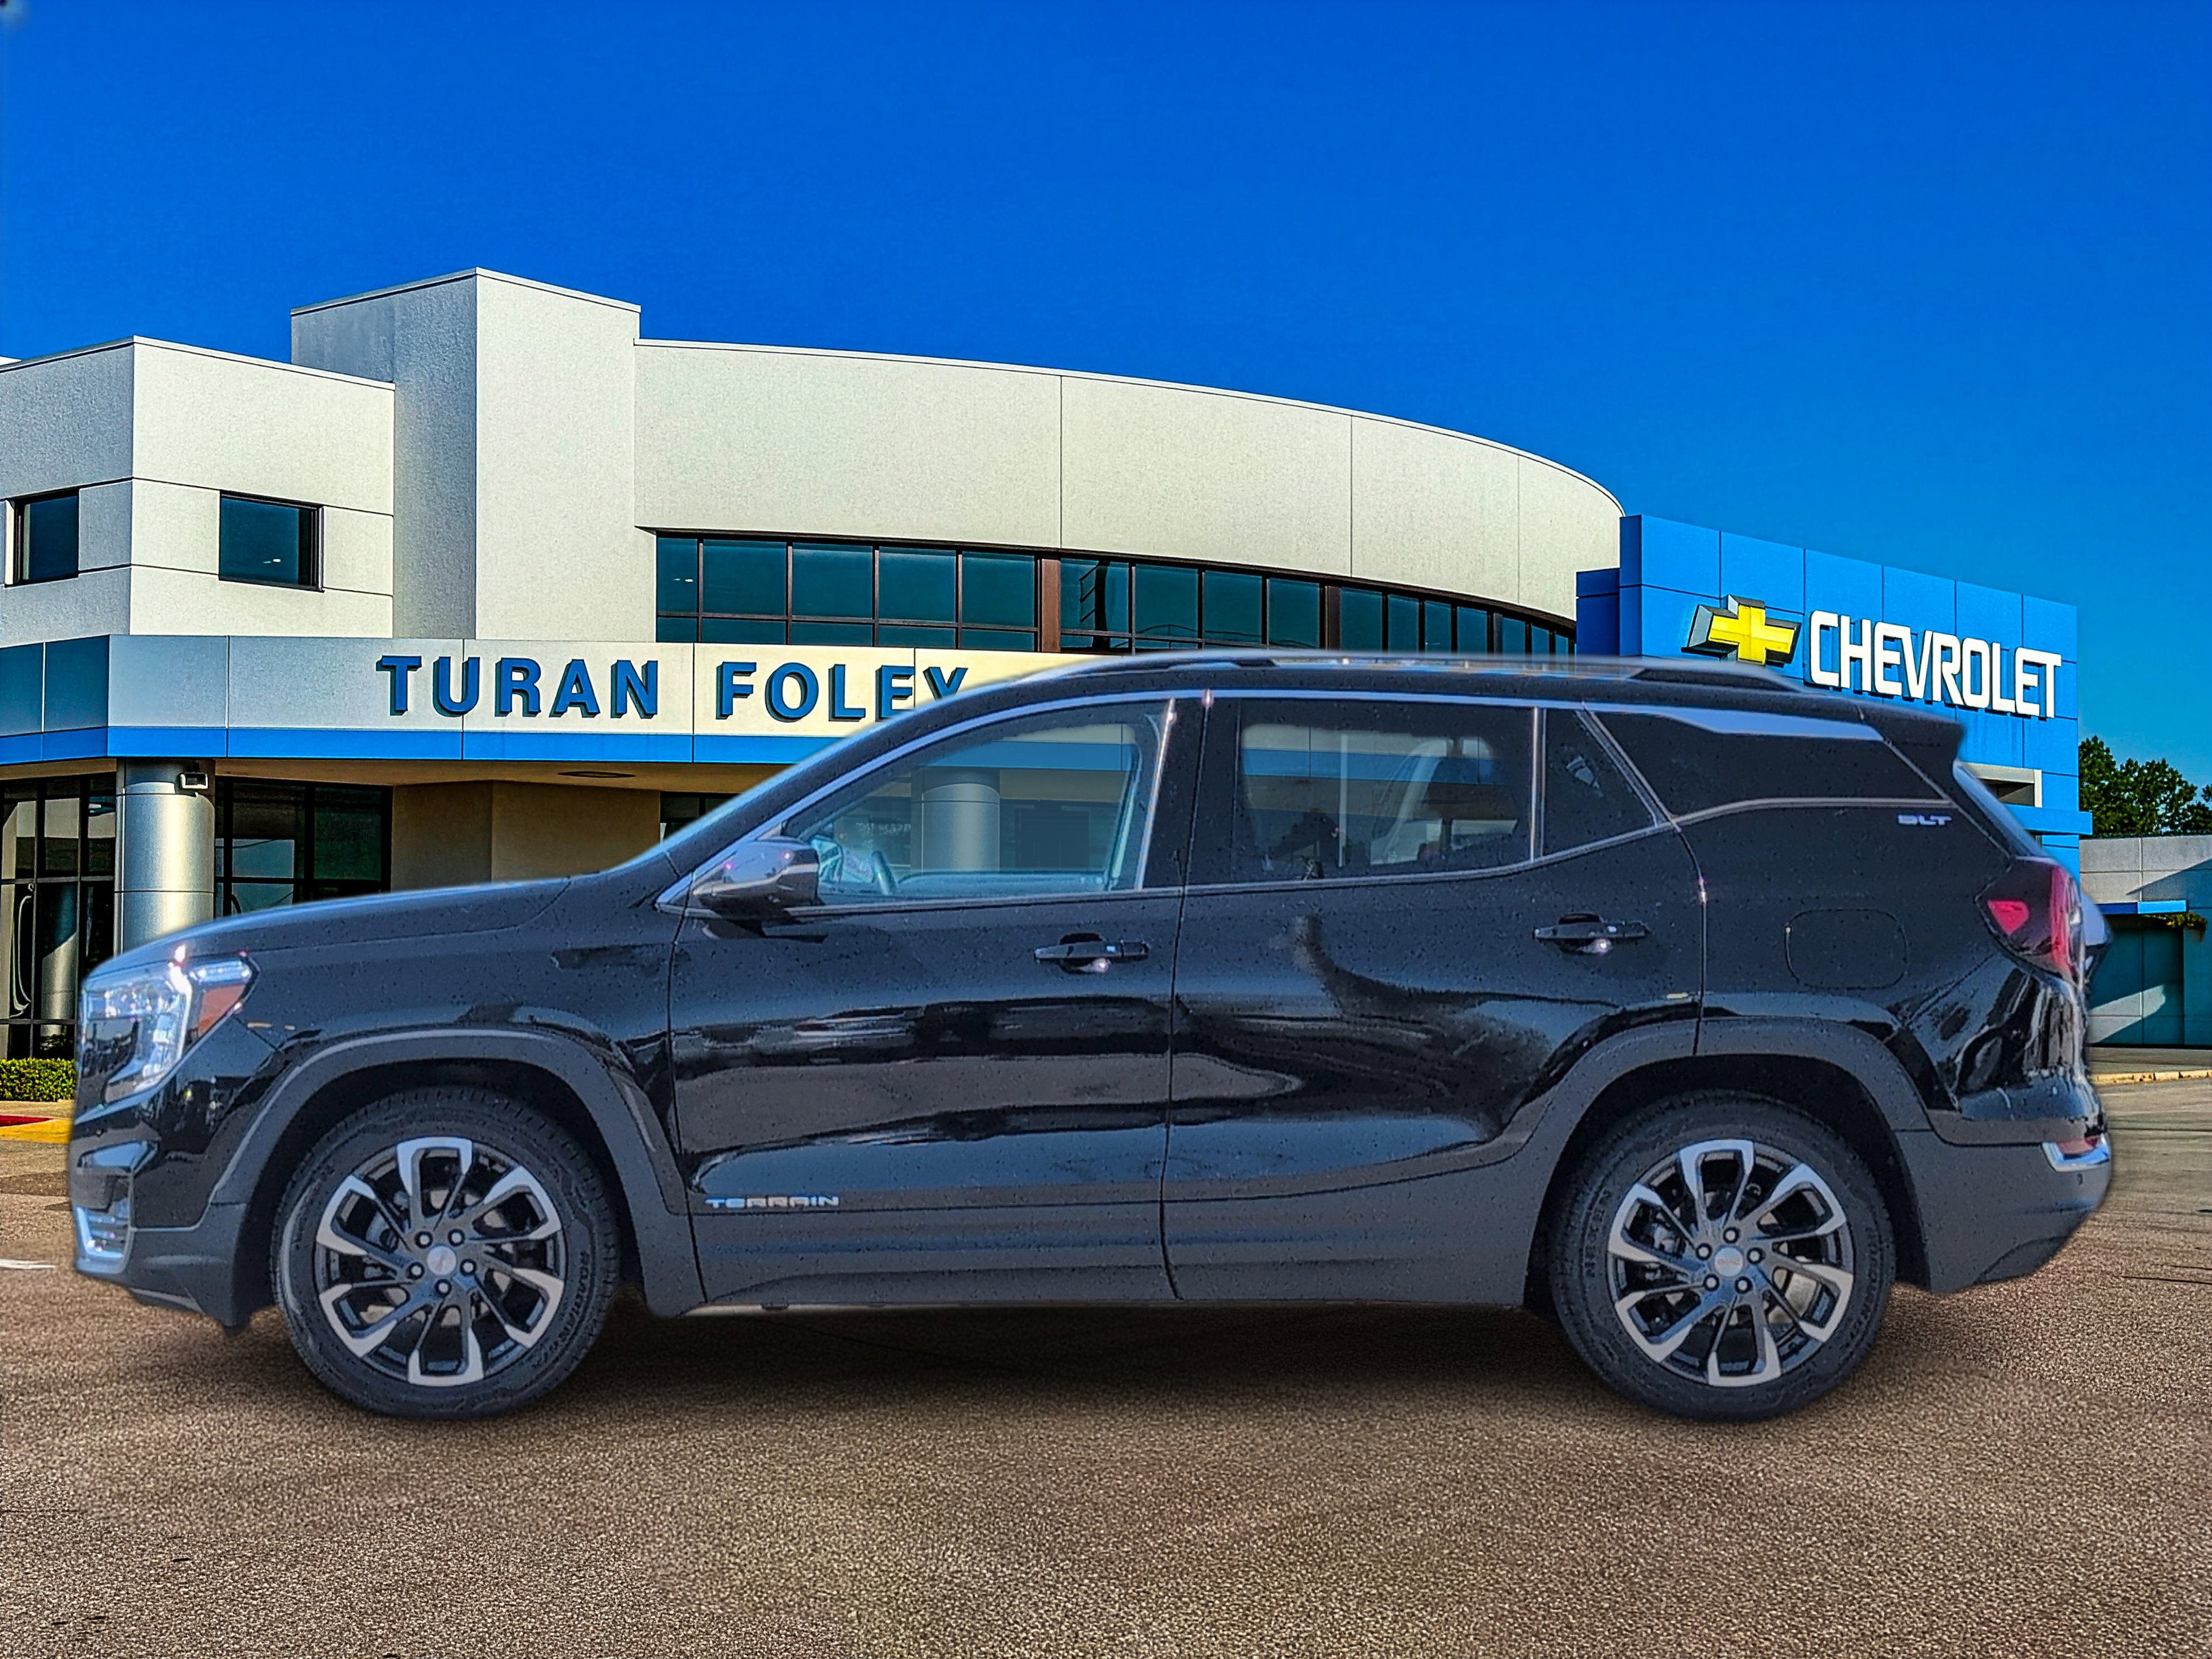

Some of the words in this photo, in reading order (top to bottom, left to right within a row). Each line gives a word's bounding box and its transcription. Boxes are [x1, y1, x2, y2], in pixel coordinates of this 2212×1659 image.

[377, 655, 658, 719] TURAN
[716, 660, 969, 722] FOLEY
[1808, 610, 2062, 719] CHEVROLET
[704, 1195, 839, 1209] TERRAIN
